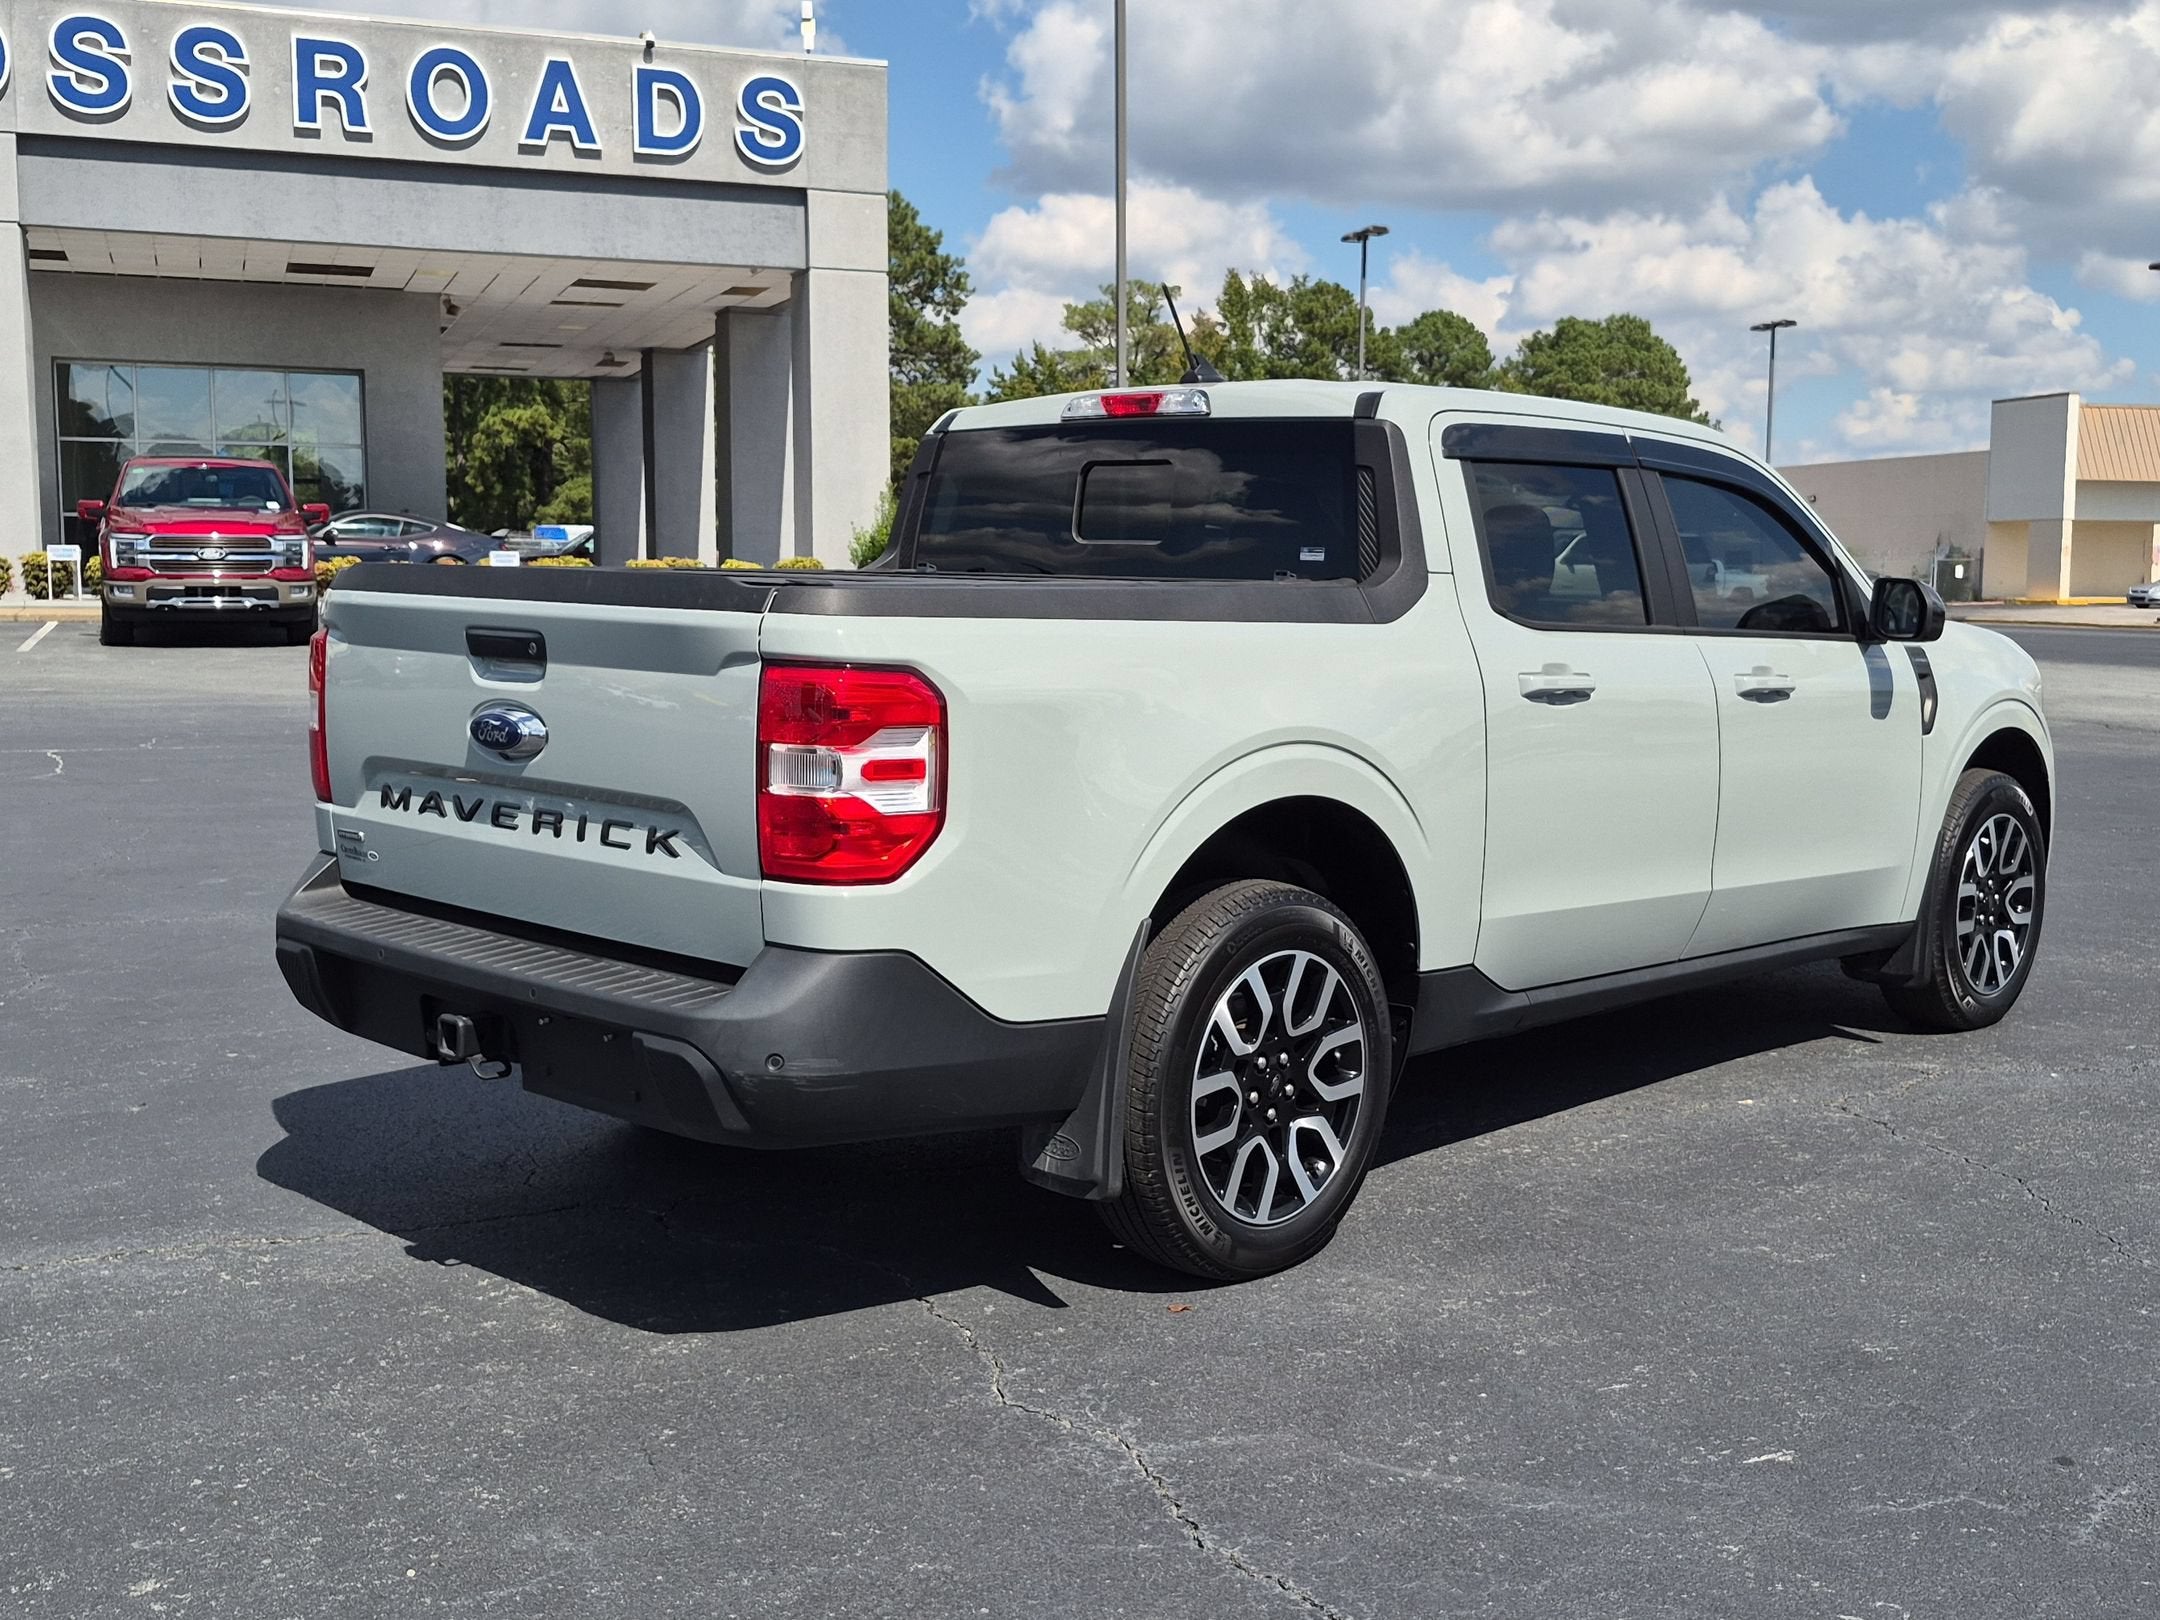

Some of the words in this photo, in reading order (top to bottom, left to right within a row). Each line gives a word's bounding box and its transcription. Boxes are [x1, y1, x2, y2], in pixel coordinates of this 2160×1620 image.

[0, 13, 806, 167] SSROADS
[478, 718, 509, 743] Ford
[380, 783, 682, 859] MAVERICK
[1172, 1152, 1214, 1237] MICHELIN
